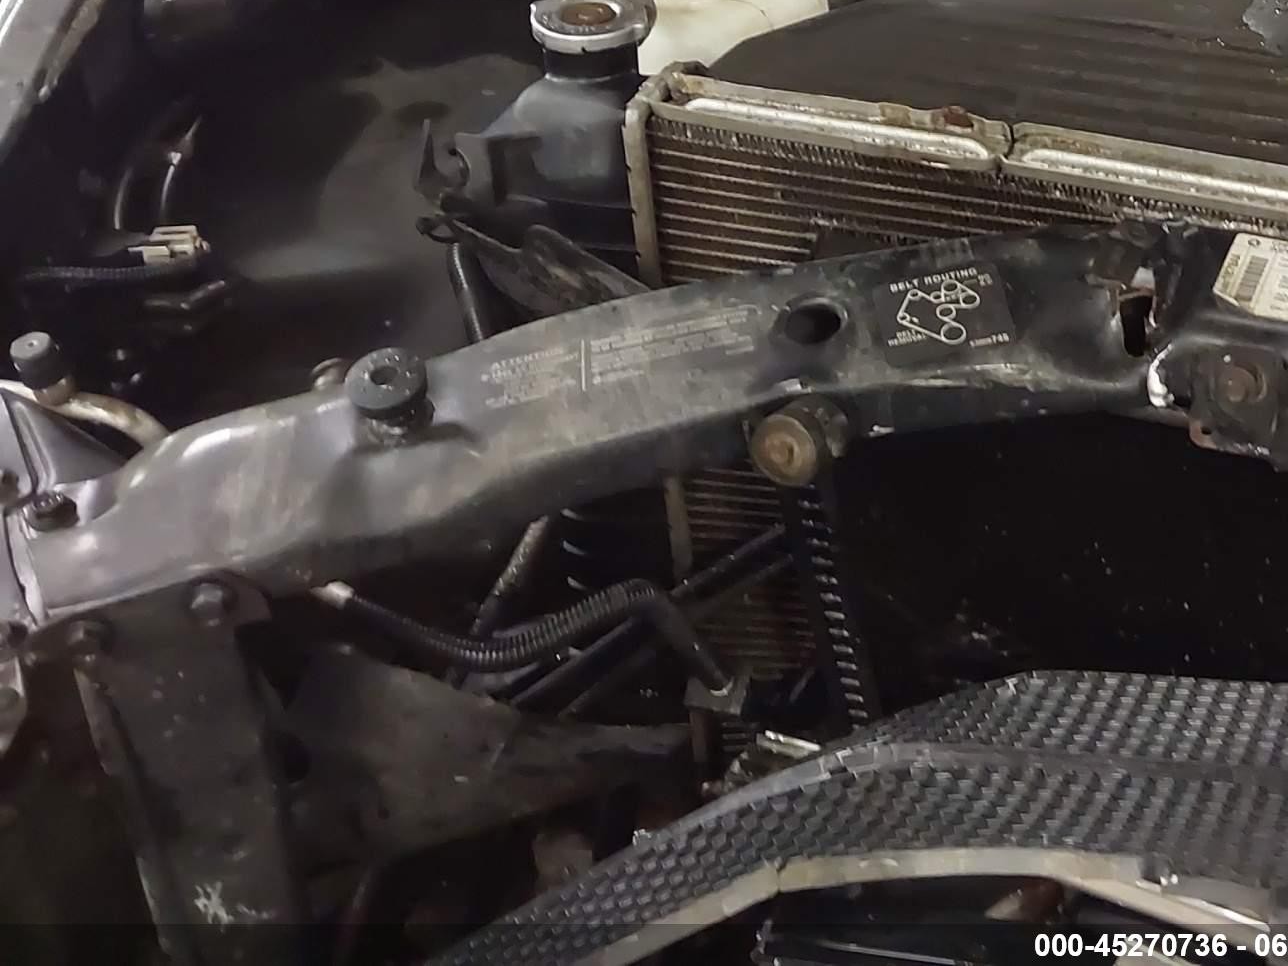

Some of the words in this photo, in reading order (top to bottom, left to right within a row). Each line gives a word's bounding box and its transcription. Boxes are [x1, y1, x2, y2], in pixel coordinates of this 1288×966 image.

[889, 279, 920, 293] BELT
[924, 266, 978, 285] ROUTING
[491, 346, 565, 370] ATTENTION
